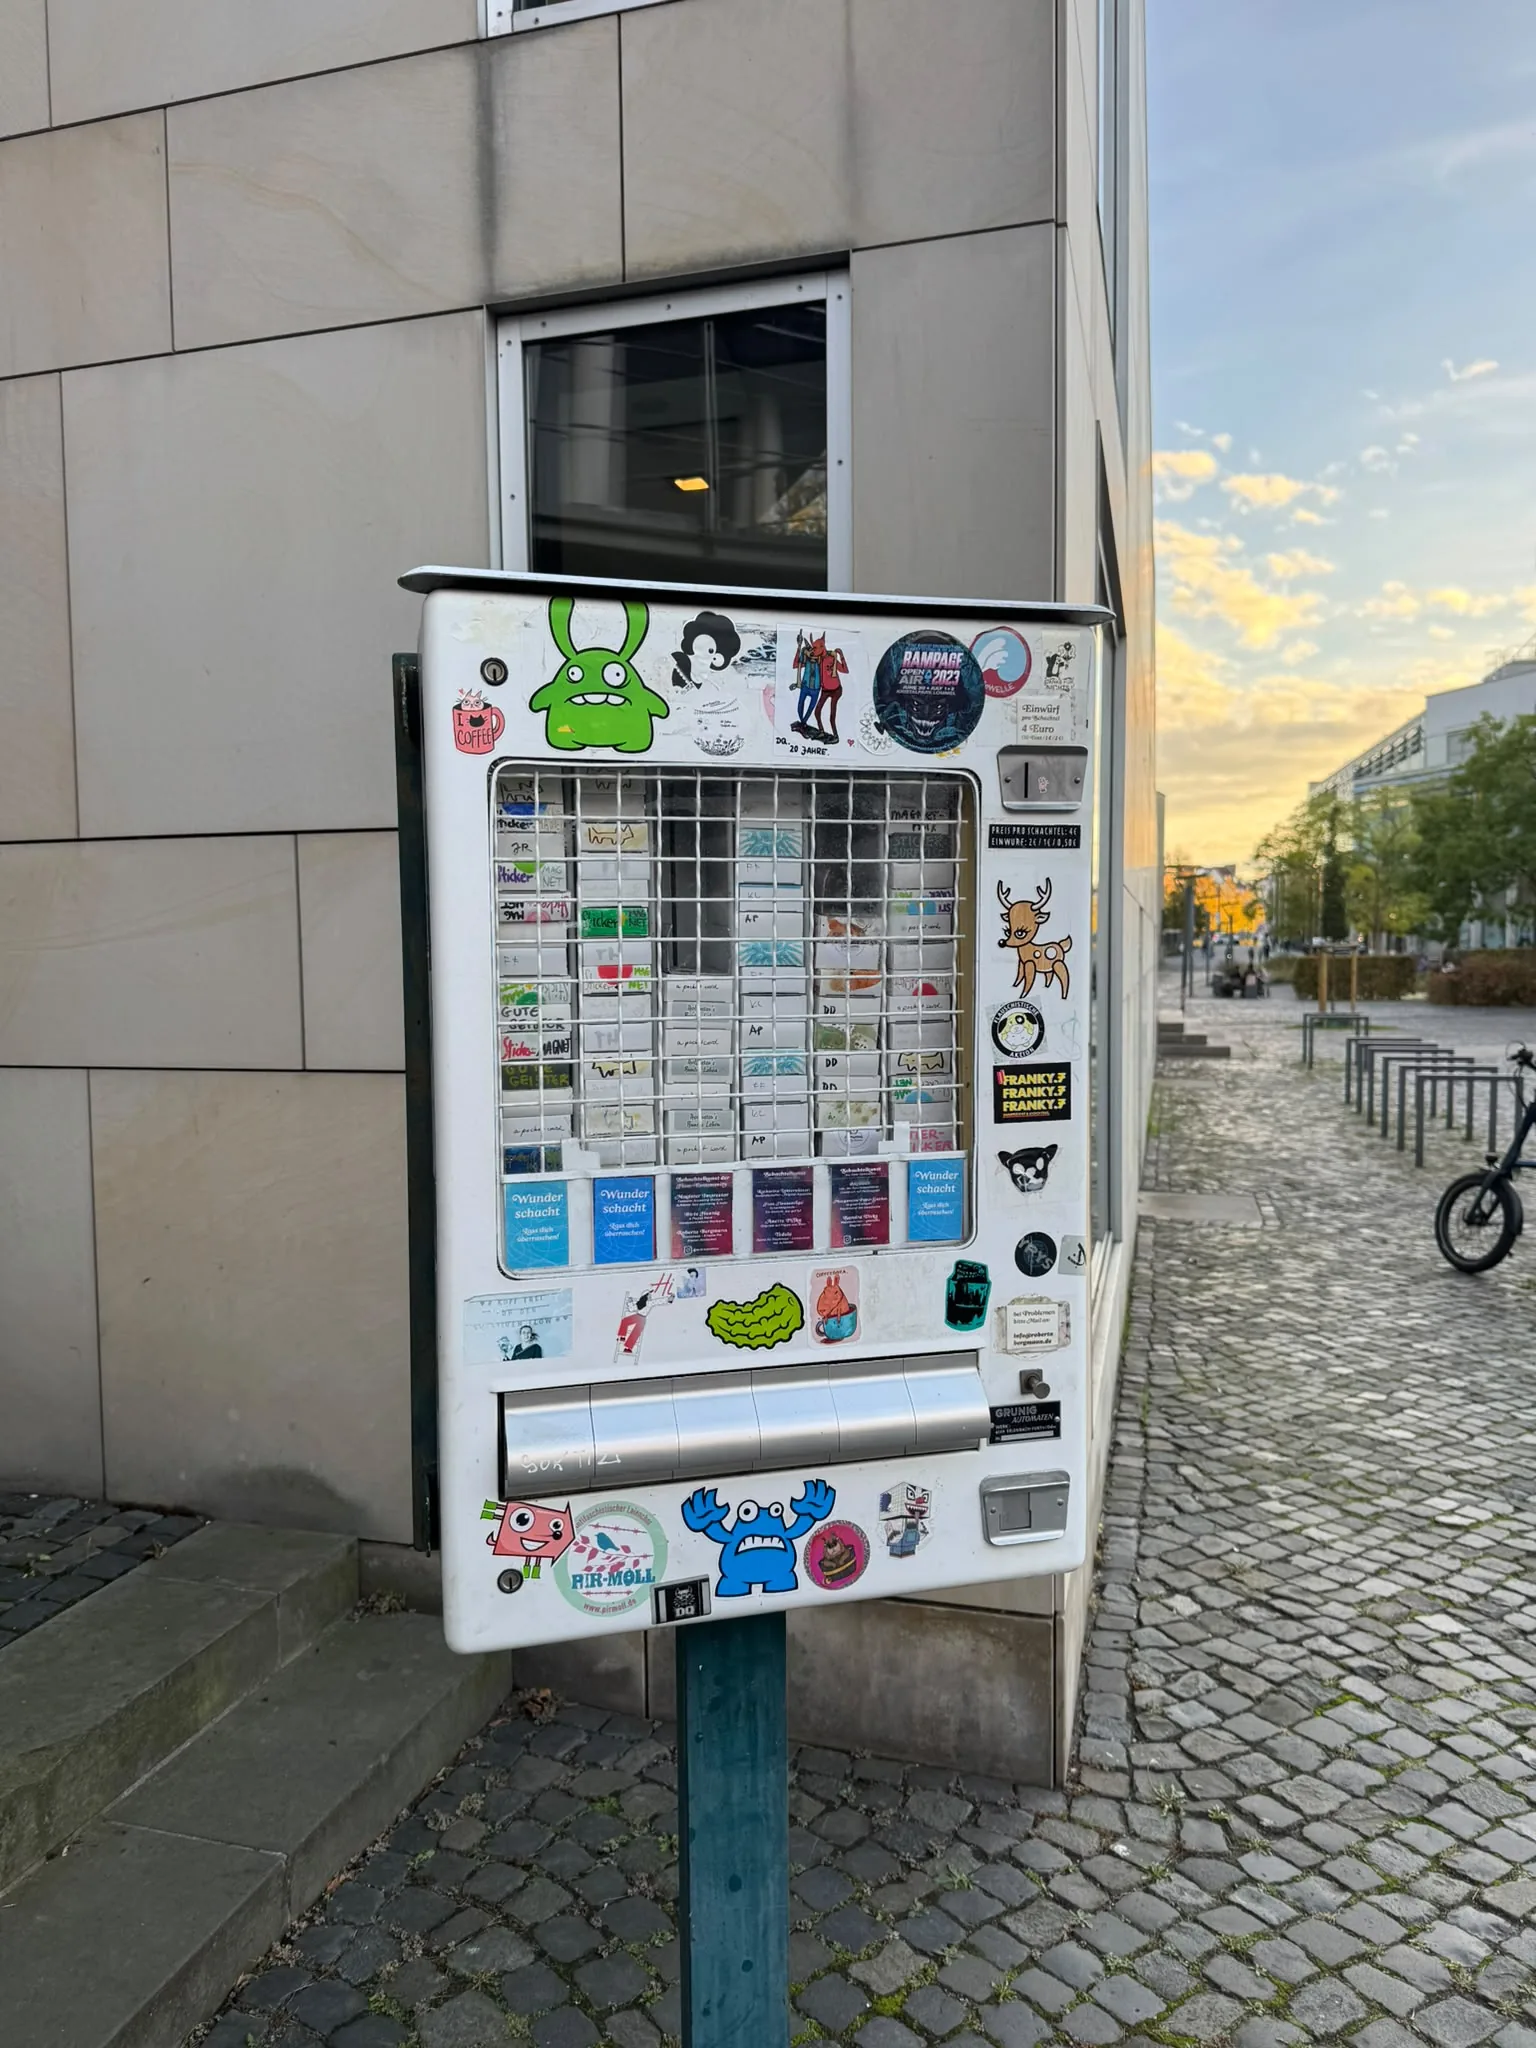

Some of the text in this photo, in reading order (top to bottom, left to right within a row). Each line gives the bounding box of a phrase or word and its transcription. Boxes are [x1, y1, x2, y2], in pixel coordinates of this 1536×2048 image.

[902, 651, 963, 669] RAMPAGE
[899, 676, 923, 684] AIR
[931, 669, 960, 686] 2023
[457, 713, 463, 726] I
[1021, 724, 1054, 733] 4 Euro
[458, 728, 491, 748] COFFEE
[790, 745, 799, 753] 20
[991, 826, 1010, 834] PREIS
[1013, 826, 1026, 835] PRO
[501, 1007, 539, 1017] GUTE
[1010, 1047, 1035, 1058] AKTION
[915, 1170, 959, 1180] Wunder
[601, 1189, 650, 1199] Wunder
[917, 1184, 955, 1194] schacht
[512, 1192, 563, 1203] Wunder
[515, 1207, 560, 1219] schacht
[603, 1202, 647, 1213] schacht
[652, 1273, 675, 1297] Hi
[1011, 1413, 1054, 1424] AUTOMATEN
